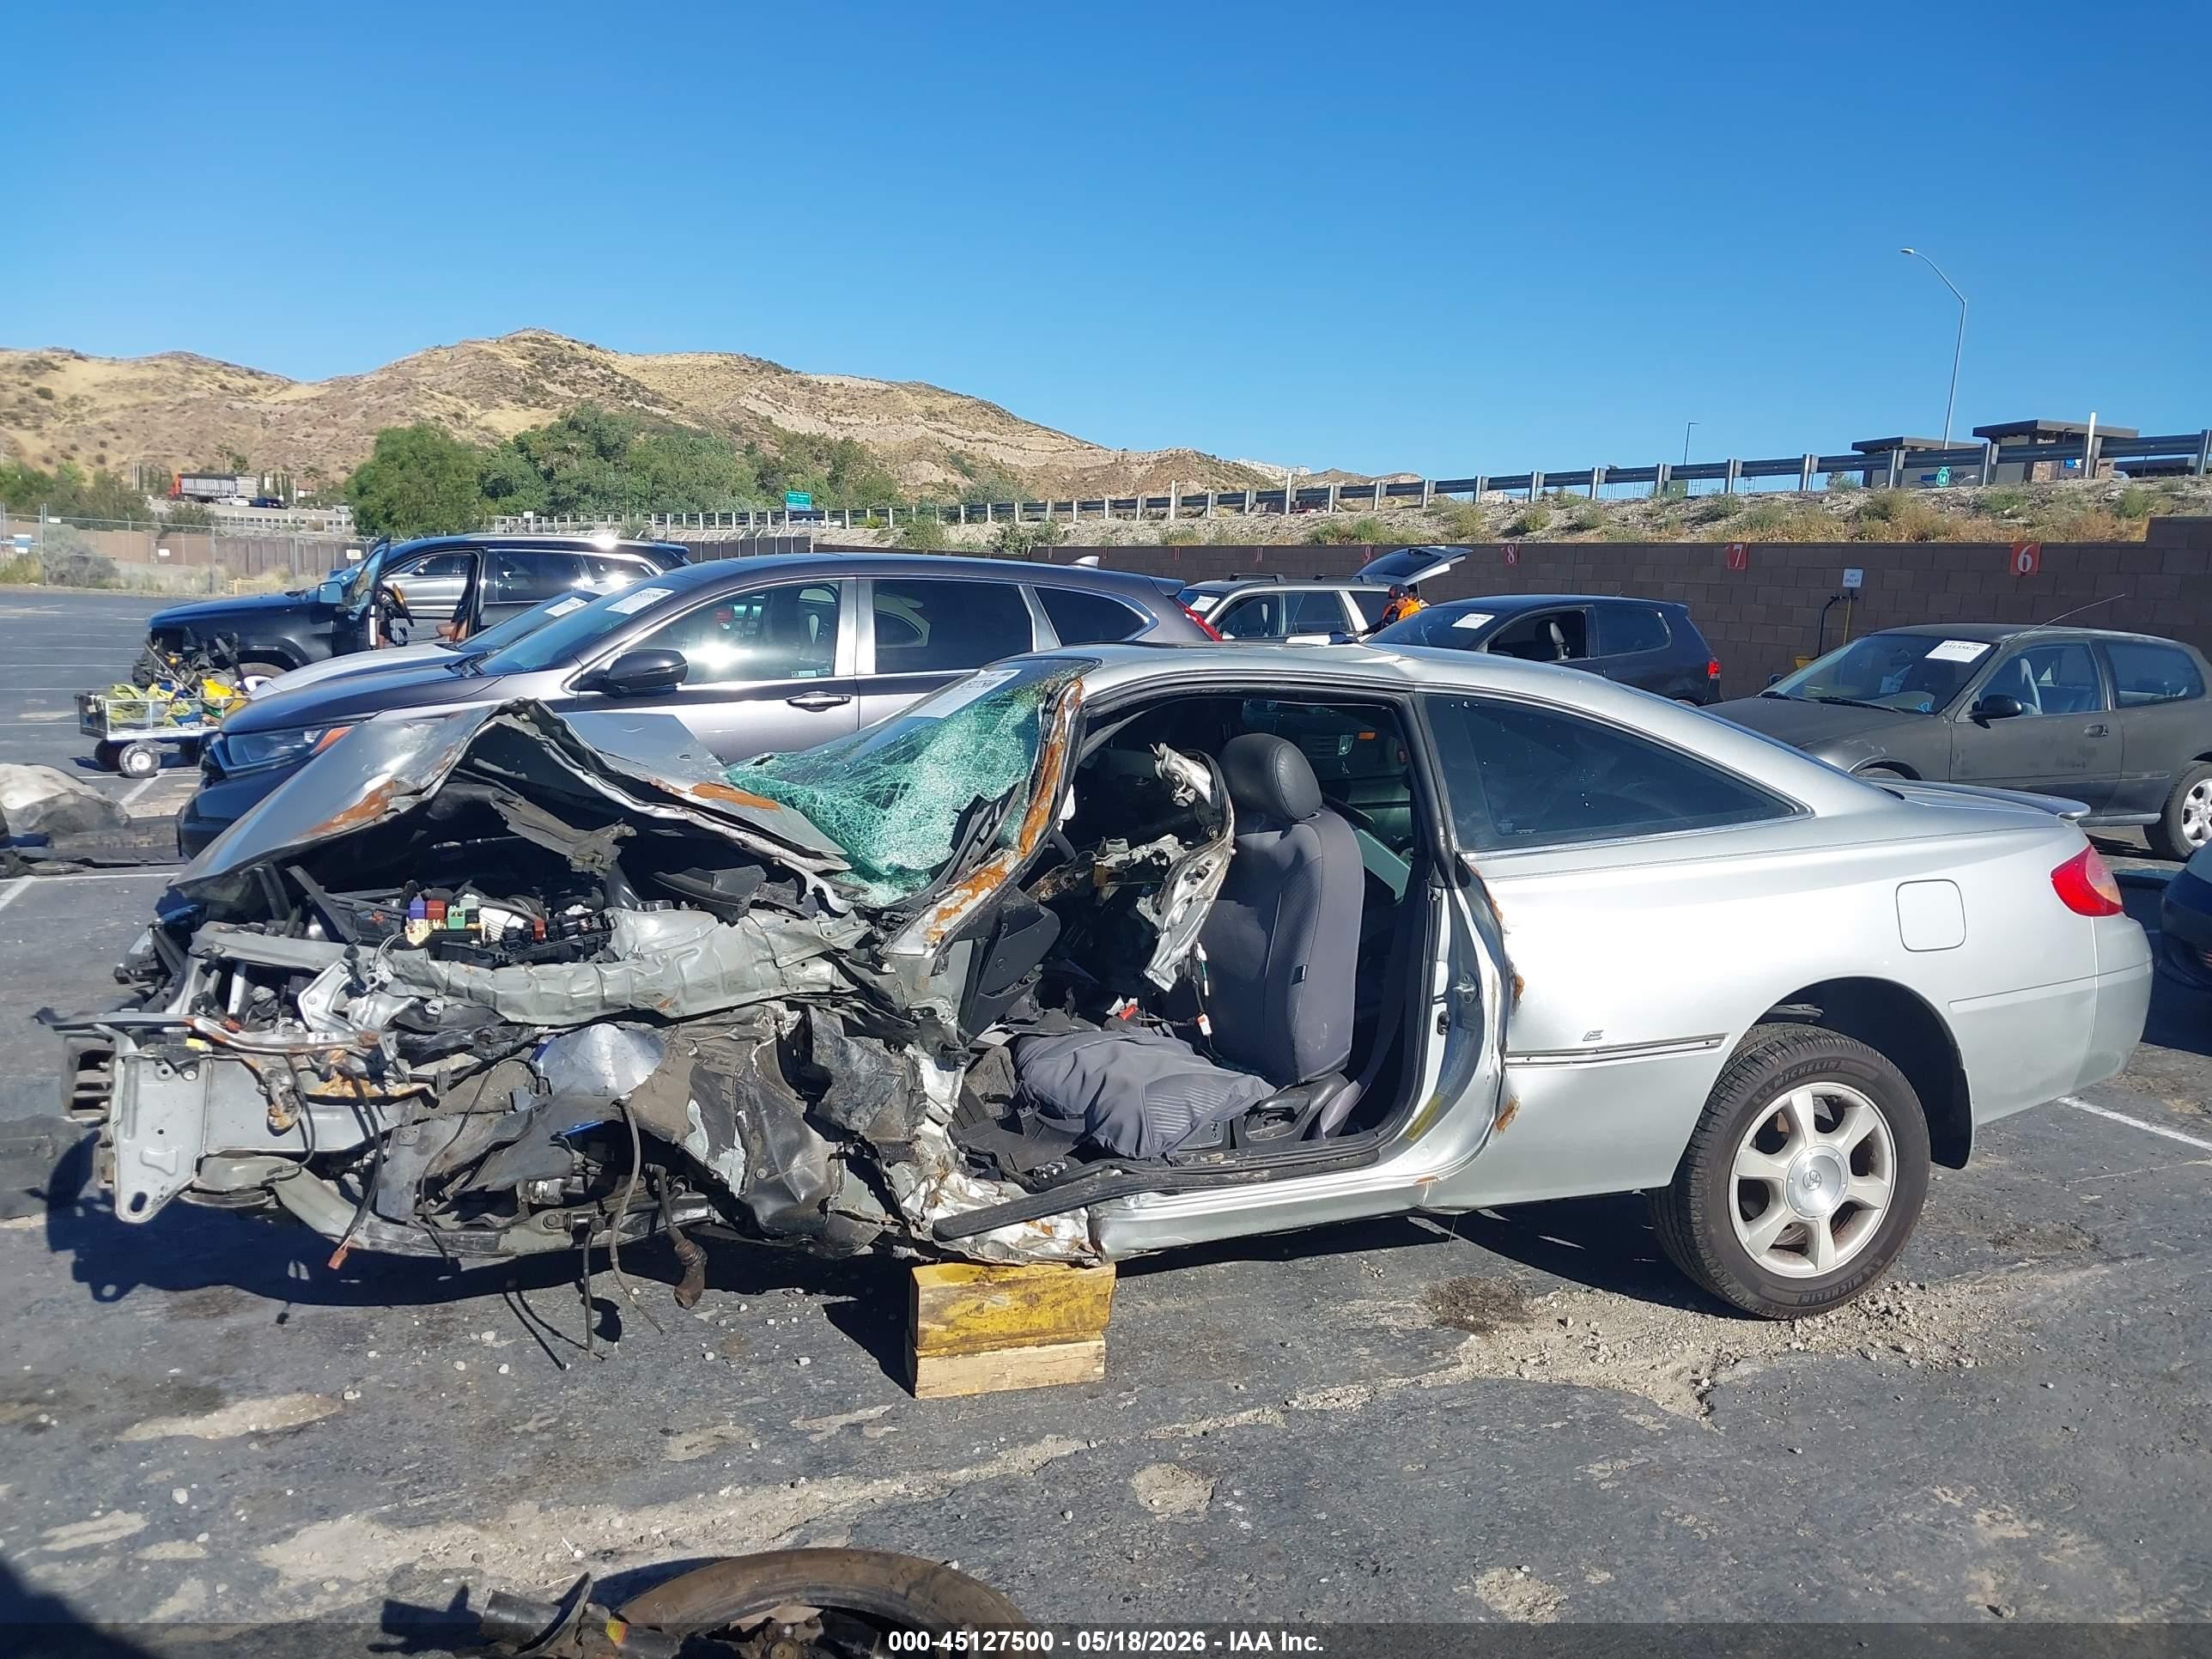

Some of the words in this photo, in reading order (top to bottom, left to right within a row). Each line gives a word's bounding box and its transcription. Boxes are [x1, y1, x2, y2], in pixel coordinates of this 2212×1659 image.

[1256, 546, 1263, 562] 10
[1364, 545, 1370, 562] 9
[1507, 544, 1515, 564] 8
[1733, 544, 1743, 568] 7
[2018, 544, 2033, 573] 6
[1773, 1060, 1841, 1089] MICHELIN
[1800, 1272, 1863, 1304] MICHELIN
